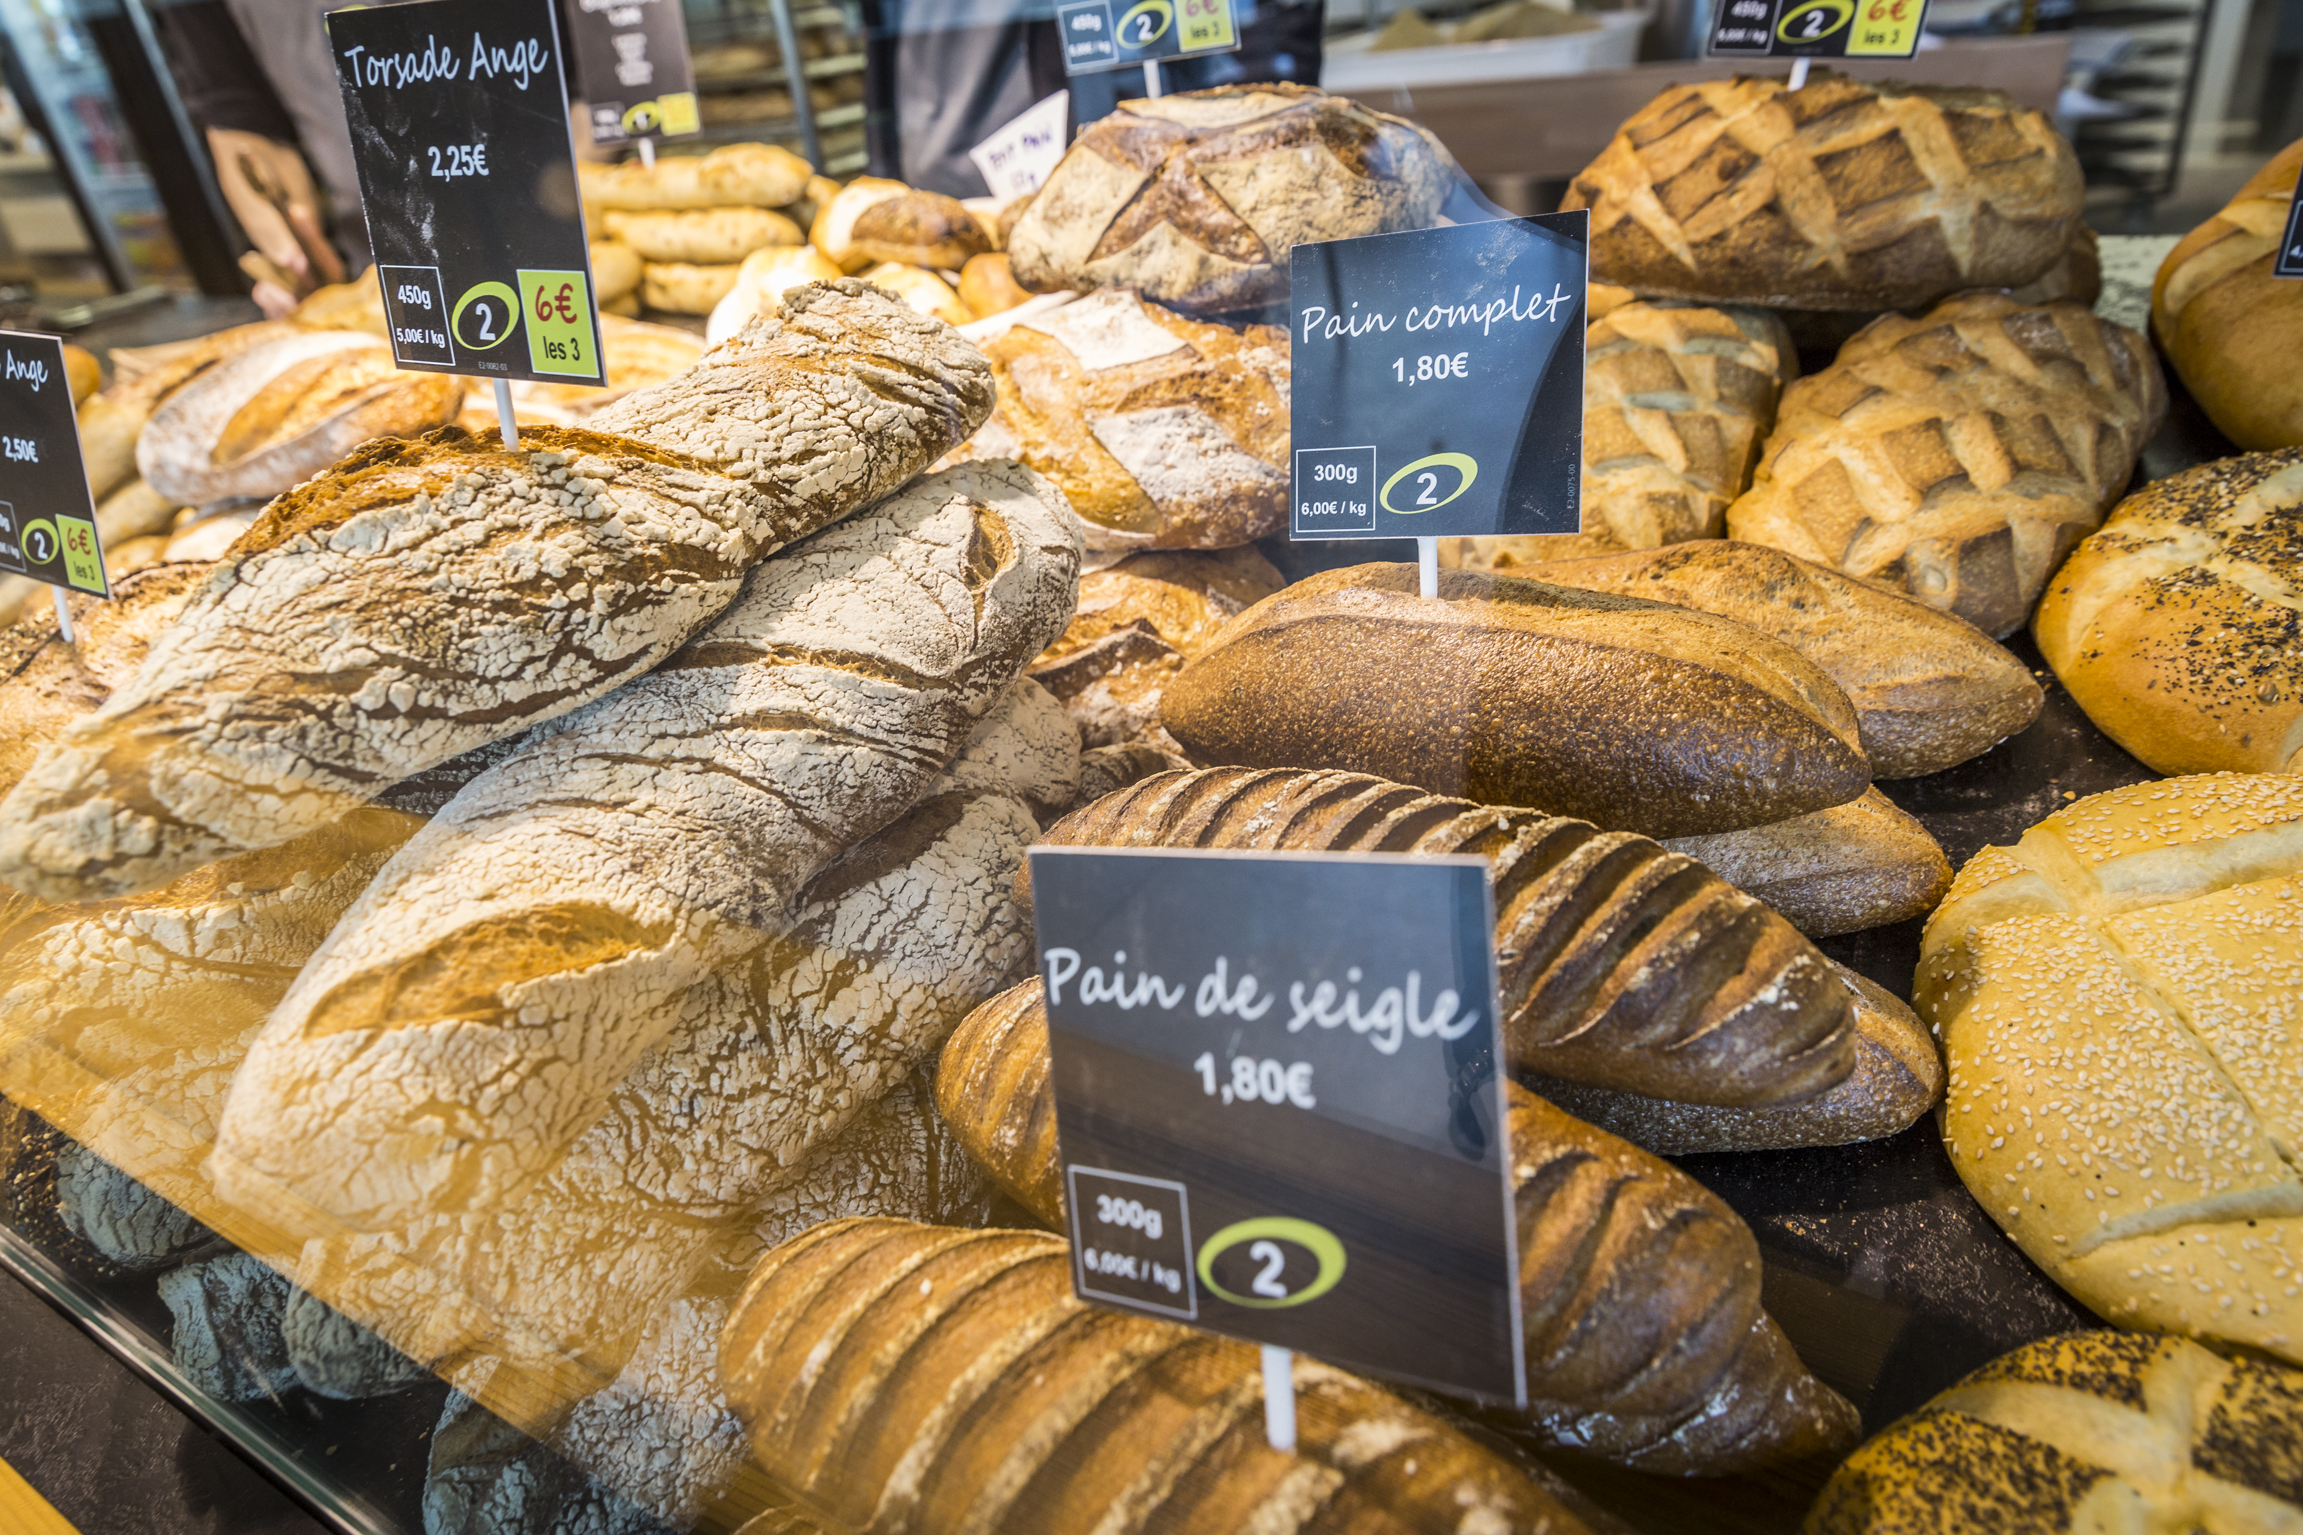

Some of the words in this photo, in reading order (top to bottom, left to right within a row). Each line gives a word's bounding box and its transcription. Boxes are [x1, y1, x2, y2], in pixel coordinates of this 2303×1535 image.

[1136, 13, 1154, 41] 2
[1802, 9, 1824, 37] 2
[1864, 28, 1886, 44] les
[1890, 28, 1901, 45] 3
[345, 35, 461, 90] Torsade
[468, 32, 549, 90] Ange
[427, 144, 490, 182] 2,25€
[397, 285, 432, 310] 450g
[535, 283, 578, 324] 6€
[1301, 301, 1397, 344] Pain
[1405, 283, 1572, 337] complet
[396, 328, 424, 345] 5,00€
[431, 329, 446, 348] kg
[475, 303, 496, 341] 2
[543, 336, 566, 361] les
[570, 338, 580, 361] 3
[5, 349, 48, 392] Ange
[1392, 352, 1470, 387] 1,80€
[2, 436, 39, 463] 2,50€
[1313, 464, 1358, 484] 300g
[1416, 472, 1438, 505] 2
[1301, 502, 1338, 517] 6,00€
[1349, 501, 1367, 517] kg
[34, 532, 48, 559] 2
[67, 527, 91, 555] 6€
[73, 561, 88, 579] les
[88, 564, 95, 581] 3
[1043, 947, 1187, 1009] Pain
[1195, 955, 1275, 1021] de
[1286, 966, 1480, 1056] seigle
[1194, 1052, 1317, 1110] 1,80€
[1097, 1194, 1163, 1239] 300g
[1084, 1247, 1138, 1280] 6,00€
[1140, 1259, 1151, 1282] /
[1152, 1261, 1181, 1294] kg
[1249, 1240, 1288, 1299] 2
